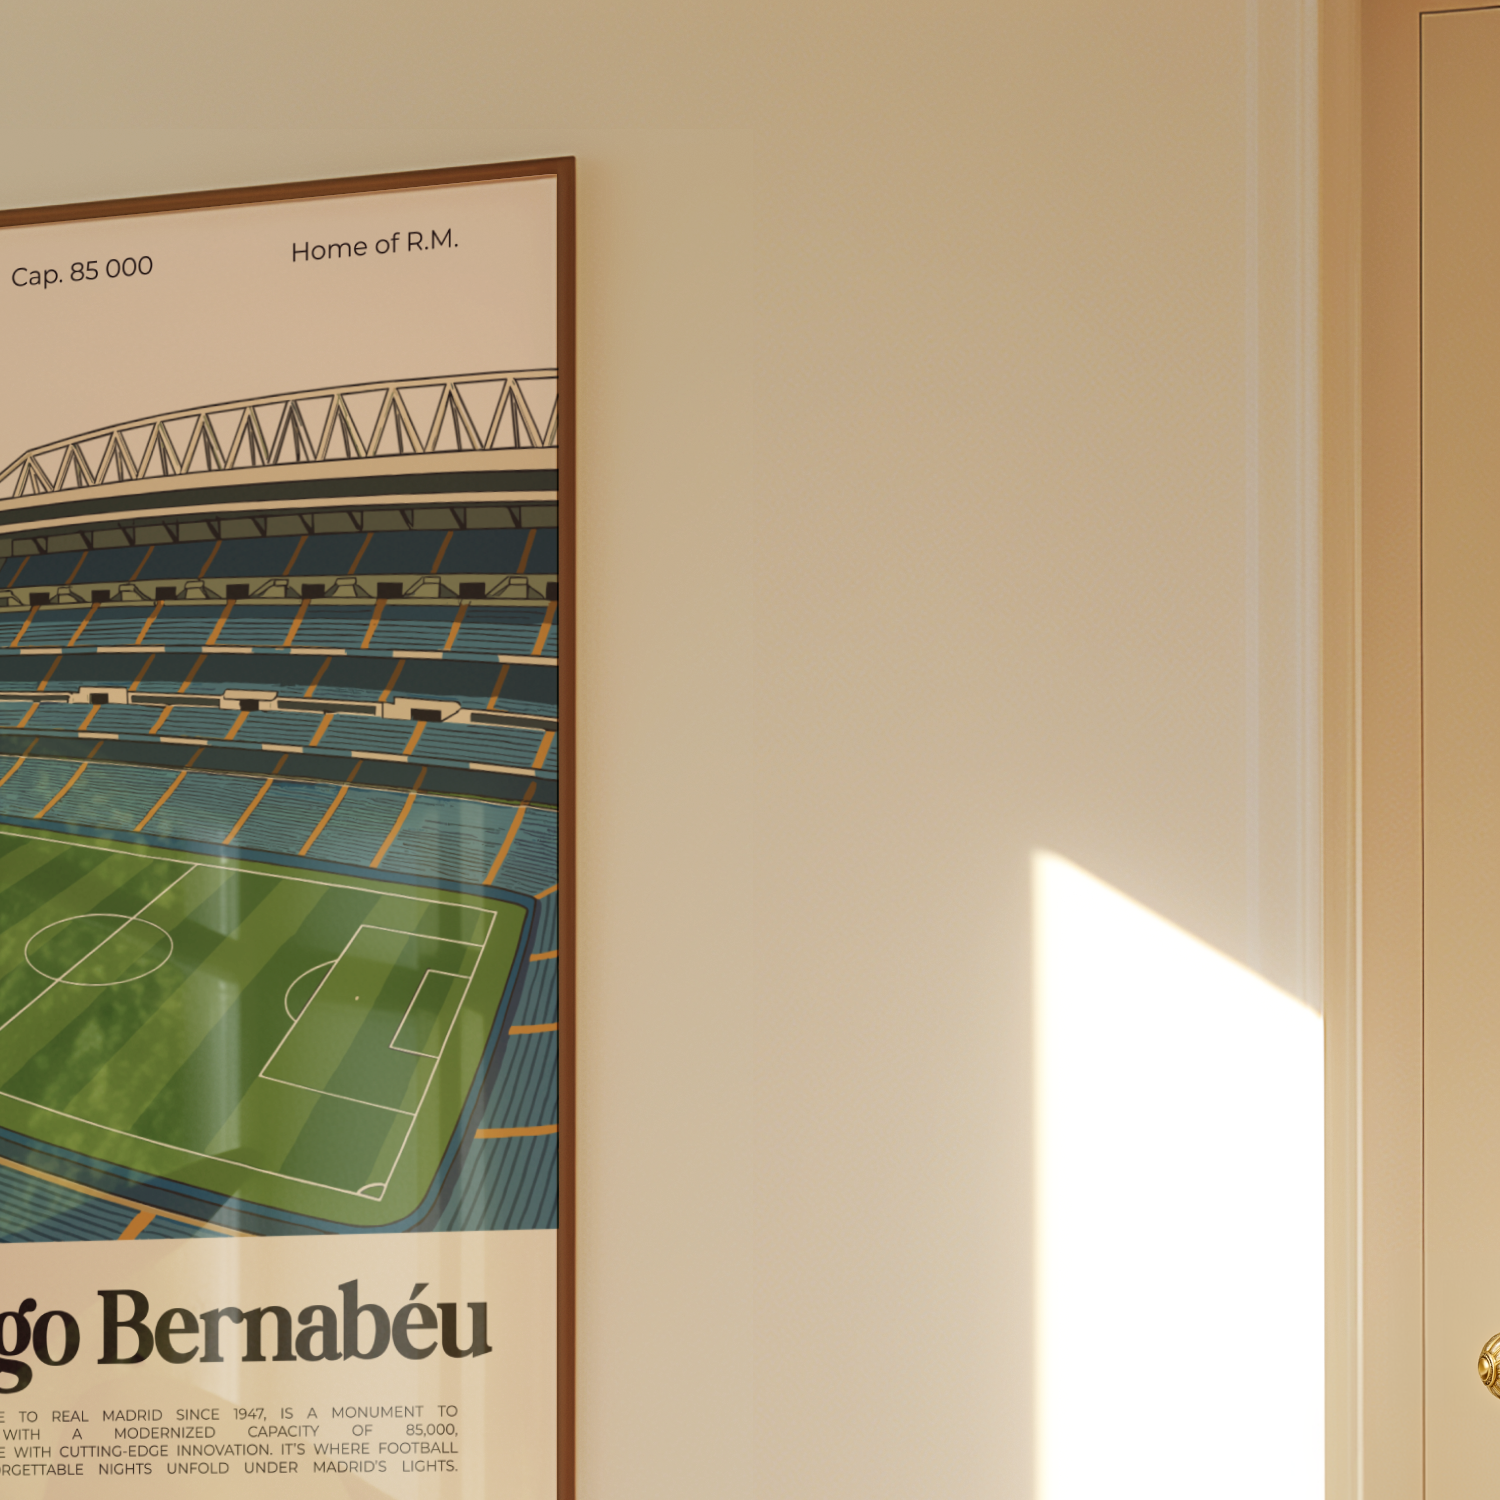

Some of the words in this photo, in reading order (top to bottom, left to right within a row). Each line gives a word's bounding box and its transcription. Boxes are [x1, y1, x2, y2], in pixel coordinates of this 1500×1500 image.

[292, 240, 368, 263] Home
[374, 231, 401, 255] of
[407, 227, 459, 252] R.M.
[11, 267, 63, 290] Cap.
[70, 260, 99, 282] 85
[105, 255, 154, 279] 000
[96, 1278, 493, 1365] Bernabéu
[18, 1410, 39, 1424] TO
[51, 1409, 90, 1423] REAL
[102, 1408, 163, 1422] MADRID
[175, 1407, 220, 1422] SINCE
[233, 1407, 267, 1422] 1947,
[280, 1406, 294, 1420] IS
[306, 1406, 318, 1420] A
[331, 1405, 424, 1419] MONUMENT
[437, 1404, 459, 1418] TO
[2, 1428, 41, 1441] WITH
[71, 1427, 83, 1441] A
[114, 1425, 216, 1440] MODERNIZED
[247, 1424, 320, 1439] CAPACITY
[351, 1423, 373, 1437] OF
[405, 1422, 459, 1438] 85,000,
[13, 1445, 52, 1459] WITH
[59, 1444, 169, 1459] CUTTING-EDGE
[176, 1443, 273, 1457] INNOVATION.
[313, 1442, 370, 1456] WHERE
[378, 1441, 459, 1455] FOOTBALL
[98, 1462, 153, 1476] NIGHTS
[166, 1461, 230, 1475] UNFOLD
[244, 1460, 299, 1475] UNDER
[402, 1459, 458, 1473] LIGHTS.
